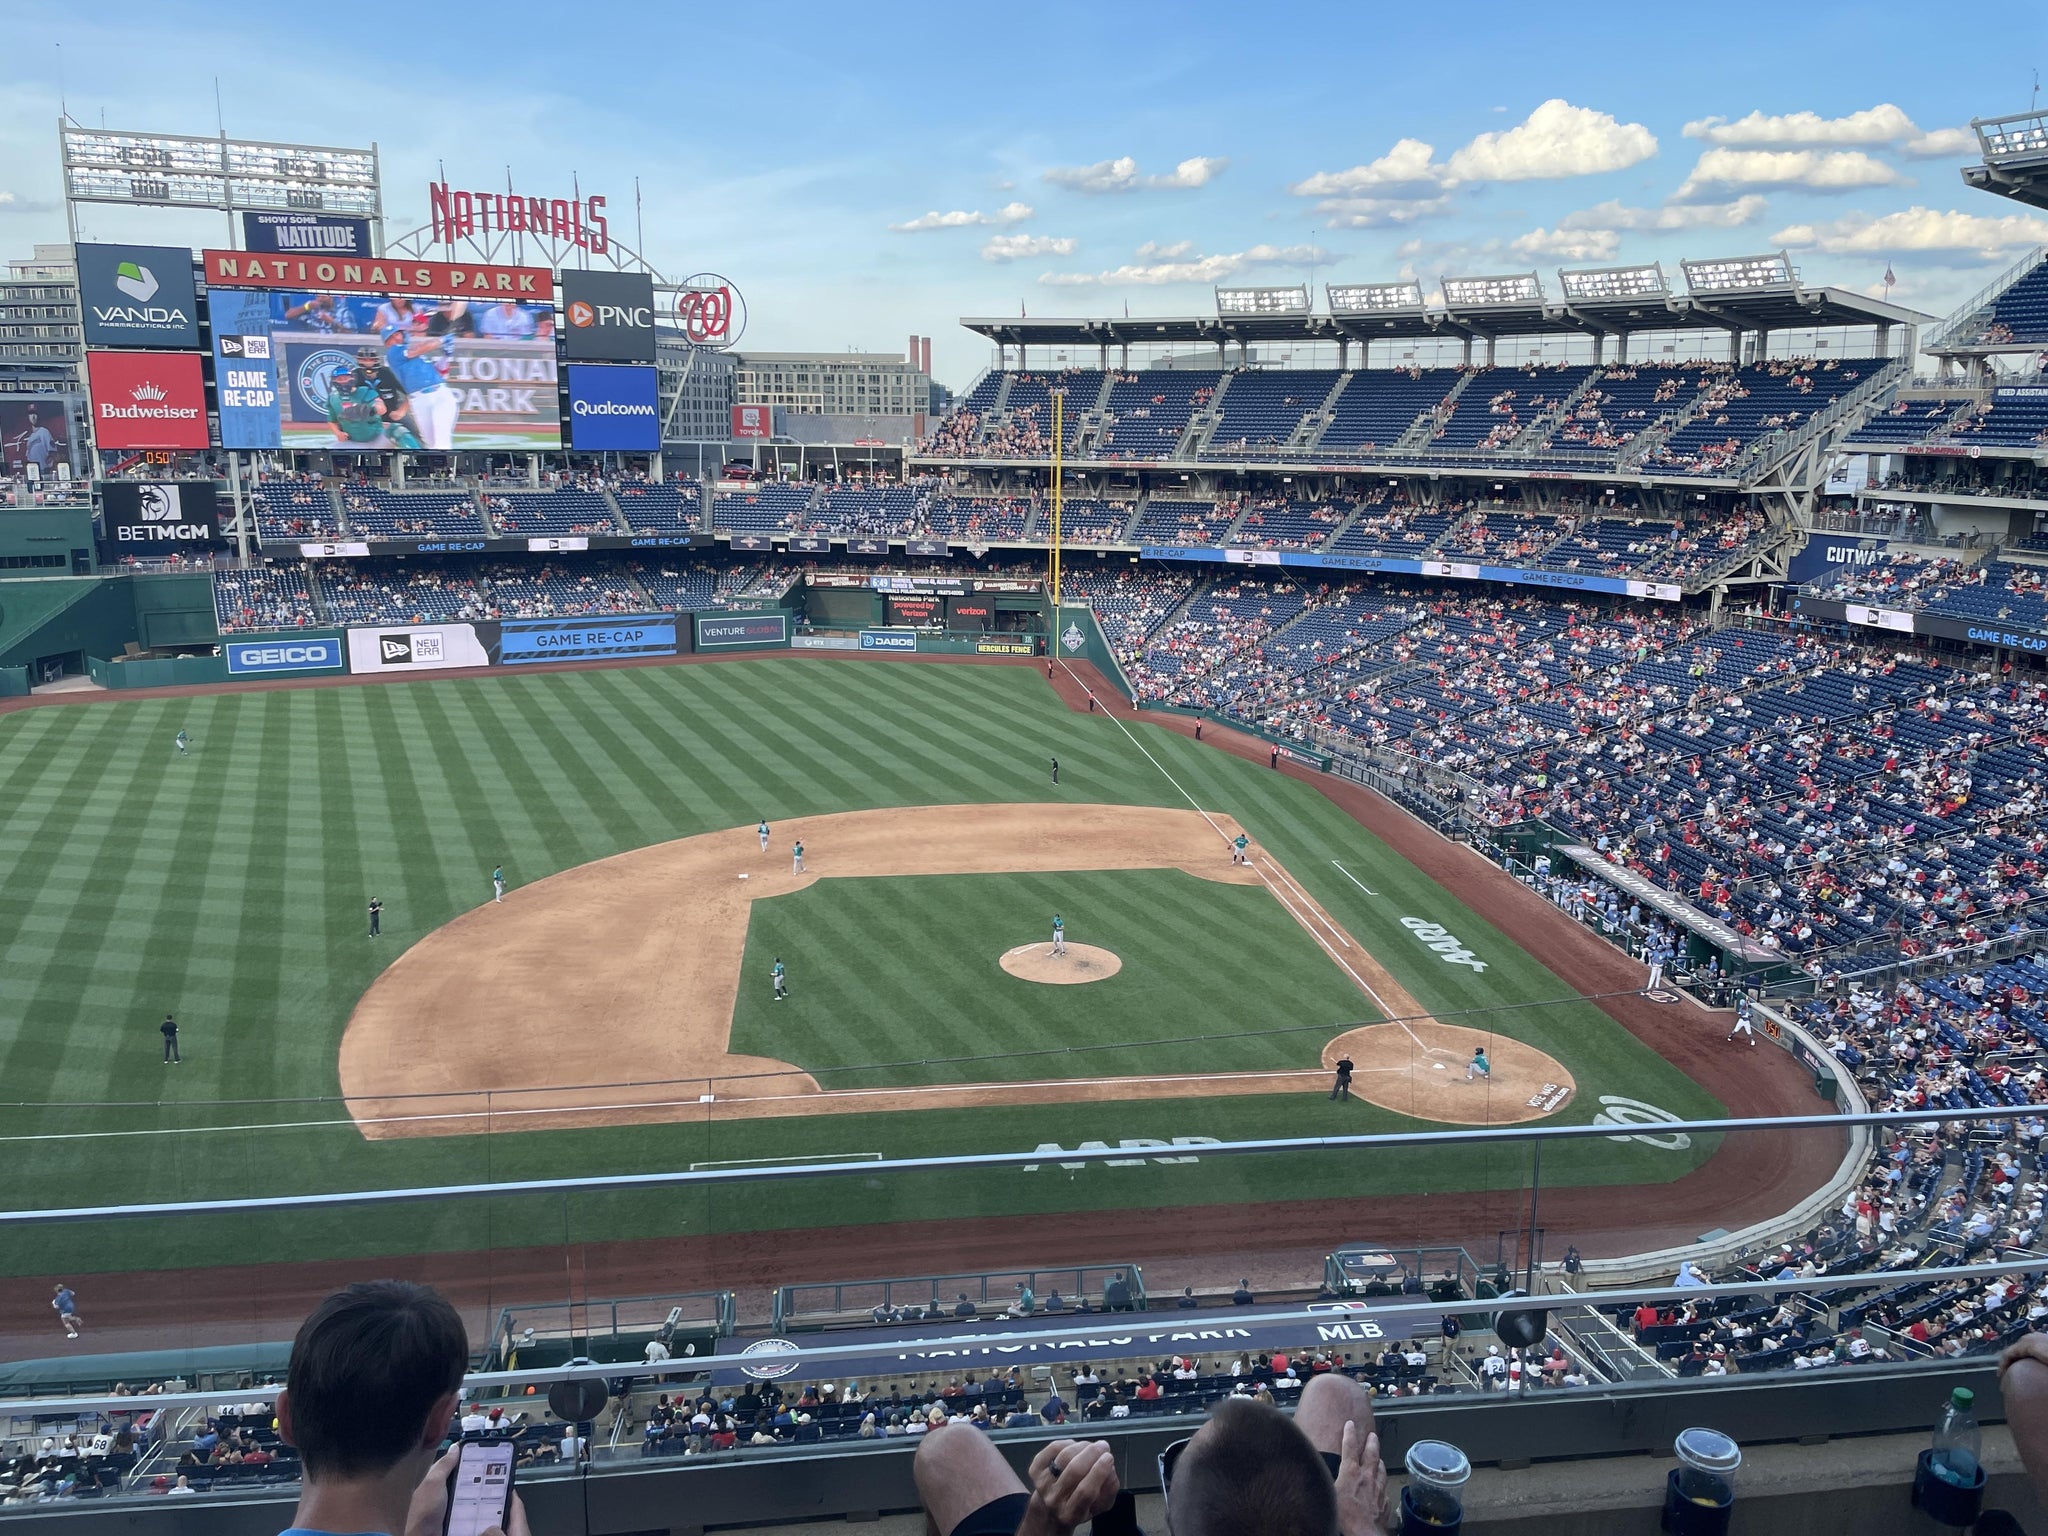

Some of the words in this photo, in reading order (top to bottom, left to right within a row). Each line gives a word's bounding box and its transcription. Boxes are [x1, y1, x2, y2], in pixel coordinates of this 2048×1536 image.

[258, 216, 288, 224] SHOW
[290, 216, 317, 224] SOME
[430, 182, 608, 254] NATIONALS
[276, 225, 356, 248] NATITUDE
[218, 258, 432, 287] NATIONALS
[451, 271, 536, 293] PARK
[93, 306, 189, 323] VANDA
[597, 305, 652, 328] PNC
[227, 371, 267, 388] GAME
[1998, 388, 2016, 396] NEED
[224, 389, 274, 407] RE-CAP
[100, 403, 199, 419] Budweiser
[573, 400, 655, 416] Qualcomm
[1907, 446, 1924, 454] RYAN
[118, 524, 209, 541] BETMGM
[418, 543, 446, 552] GAME
[449, 542, 485, 551] RE-CAP
[631, 538, 656, 546] GAME
[659, 537, 691, 546] RE-CAP
[1322, 557, 1347, 566] GAME
[1349, 559, 1382, 568] RE-CAP
[872, 578, 888, 587] 6:49
[1522, 572, 1548, 583] GAME
[1551, 575, 1585, 586] RE-CAP
[889, 594, 922, 602] Nationals
[894, 602, 924, 610] powered
[925, 602, 935, 610] by
[956, 606, 987, 615] verizon
[901, 609, 928, 617] Verizon
[704, 627, 745, 637] VENTURE
[746, 626, 778, 635] GLOBAL
[416, 639, 439, 647] NEW
[536, 632, 582, 647] GAME
[587, 631, 644, 645] RE-CAP
[875, 637, 914, 647] DABOS
[1968, 628, 2000, 643] GAME
[2003, 633, 2047, 650] RE-CAP
[417, 647, 439, 656] ERA
[978, 644, 1010, 653] HERCULES
[1011, 645, 1031, 654] FENCE
[240, 646, 327, 666] GEICO
[1400, 916, 1489, 973] AARP
[1317, 1322, 1385, 1341] MLB
[222, 1407, 234, 1416] 44
[93, 1440, 108, 1450] 68
